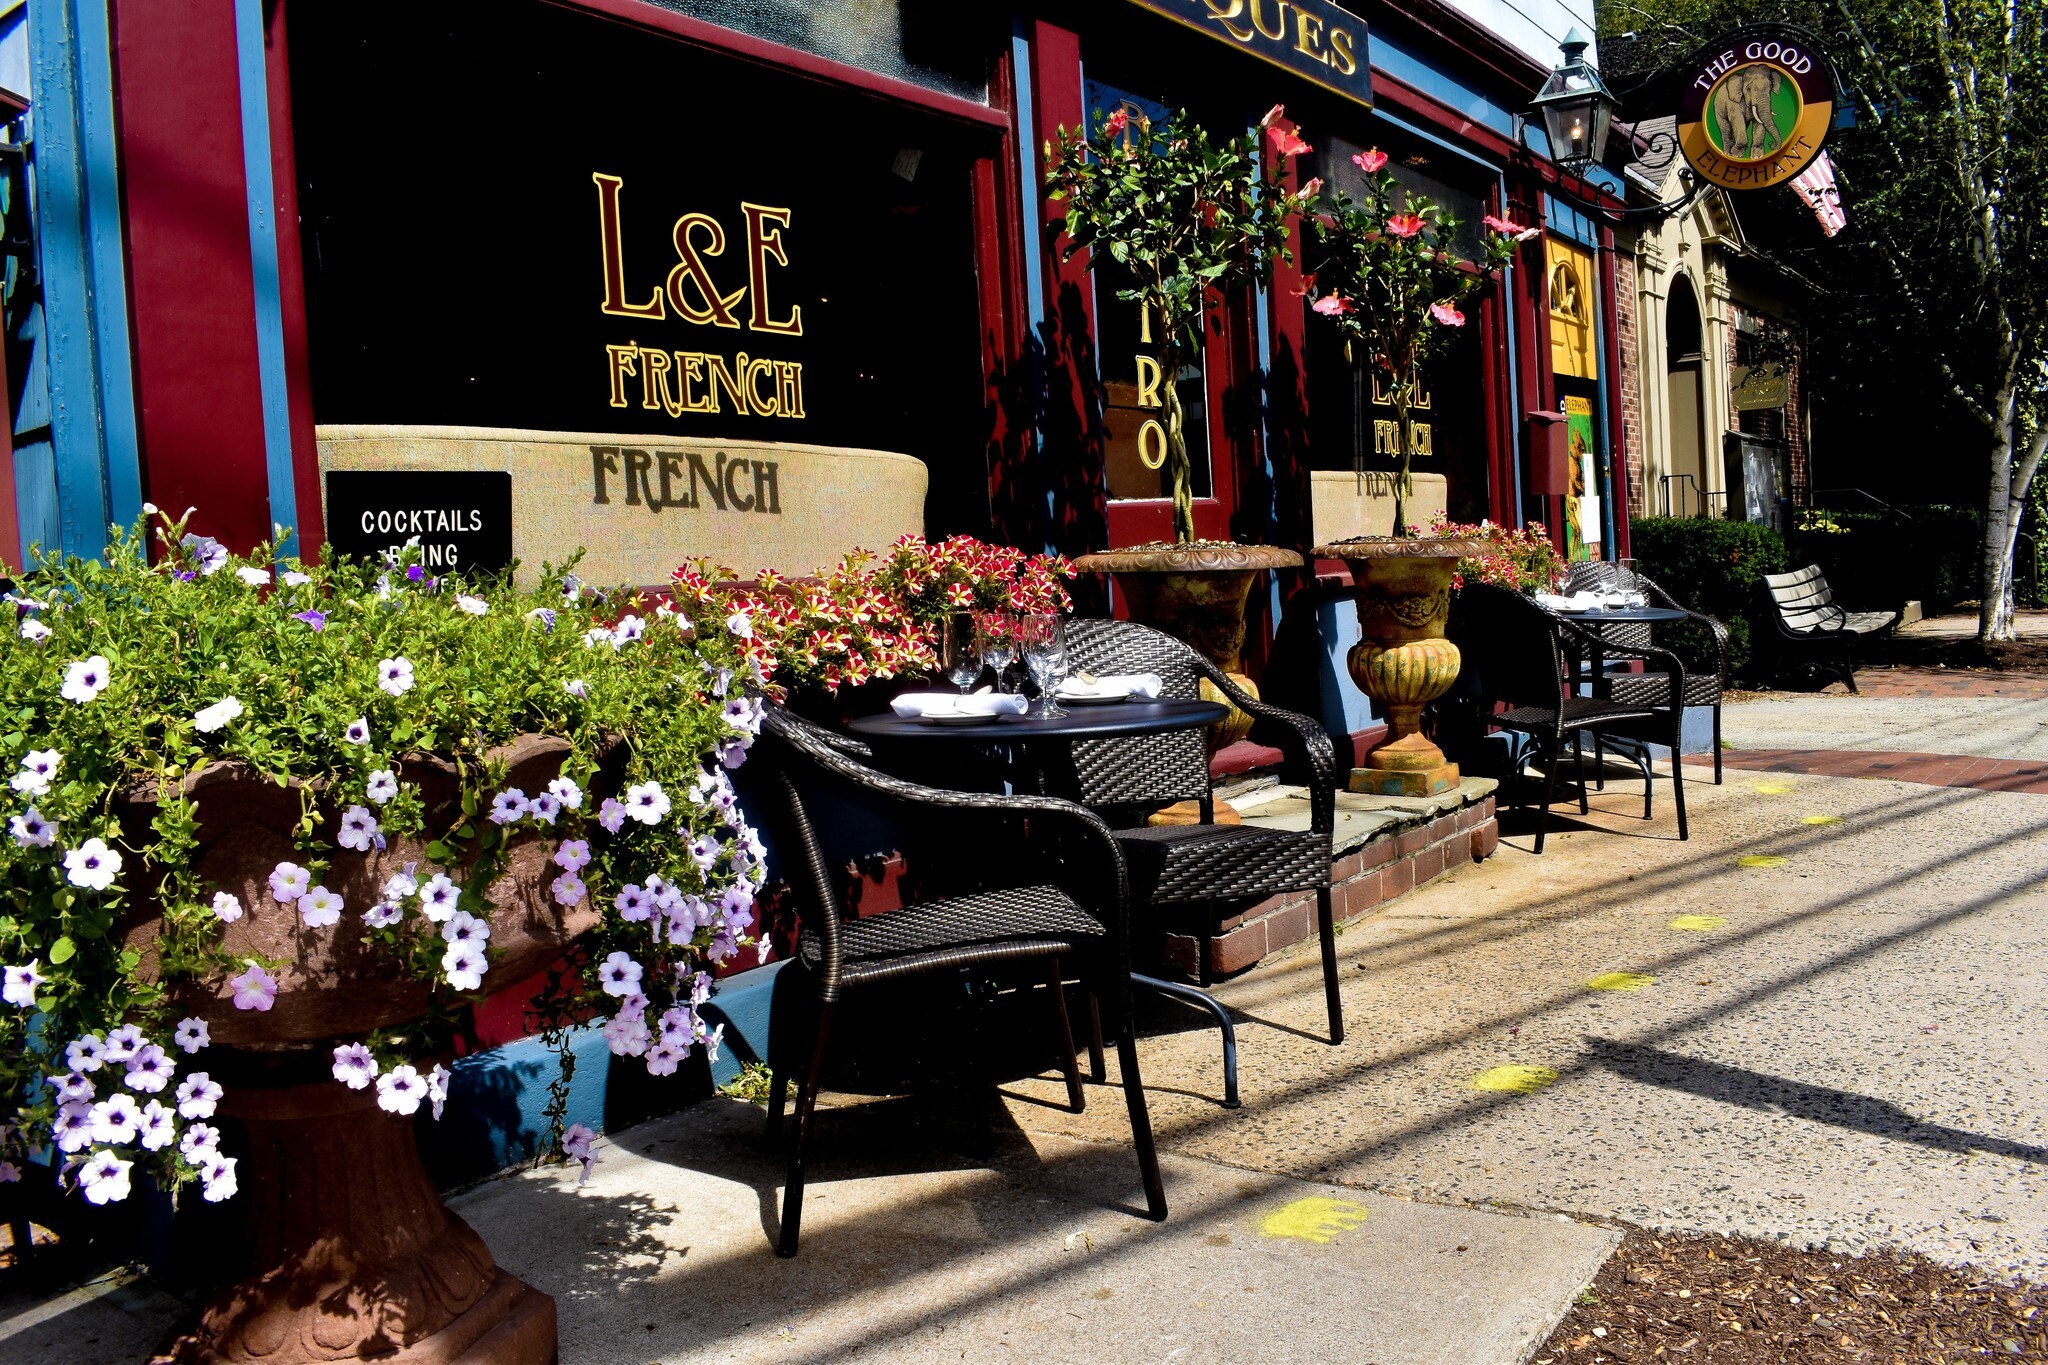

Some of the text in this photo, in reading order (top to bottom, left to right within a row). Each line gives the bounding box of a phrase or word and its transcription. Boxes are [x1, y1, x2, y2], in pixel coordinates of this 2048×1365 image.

[1694, 42, 1812, 91] THE GOOD
[1696, 135, 1813, 184] ELEPHANT
[592, 172, 803, 336] L&E
[606, 344, 805, 419] FRENCH
[589, 446, 782, 514] FRENCH
[361, 509, 482, 534] COCKTAILS
[389, 544, 458, 567] BING
